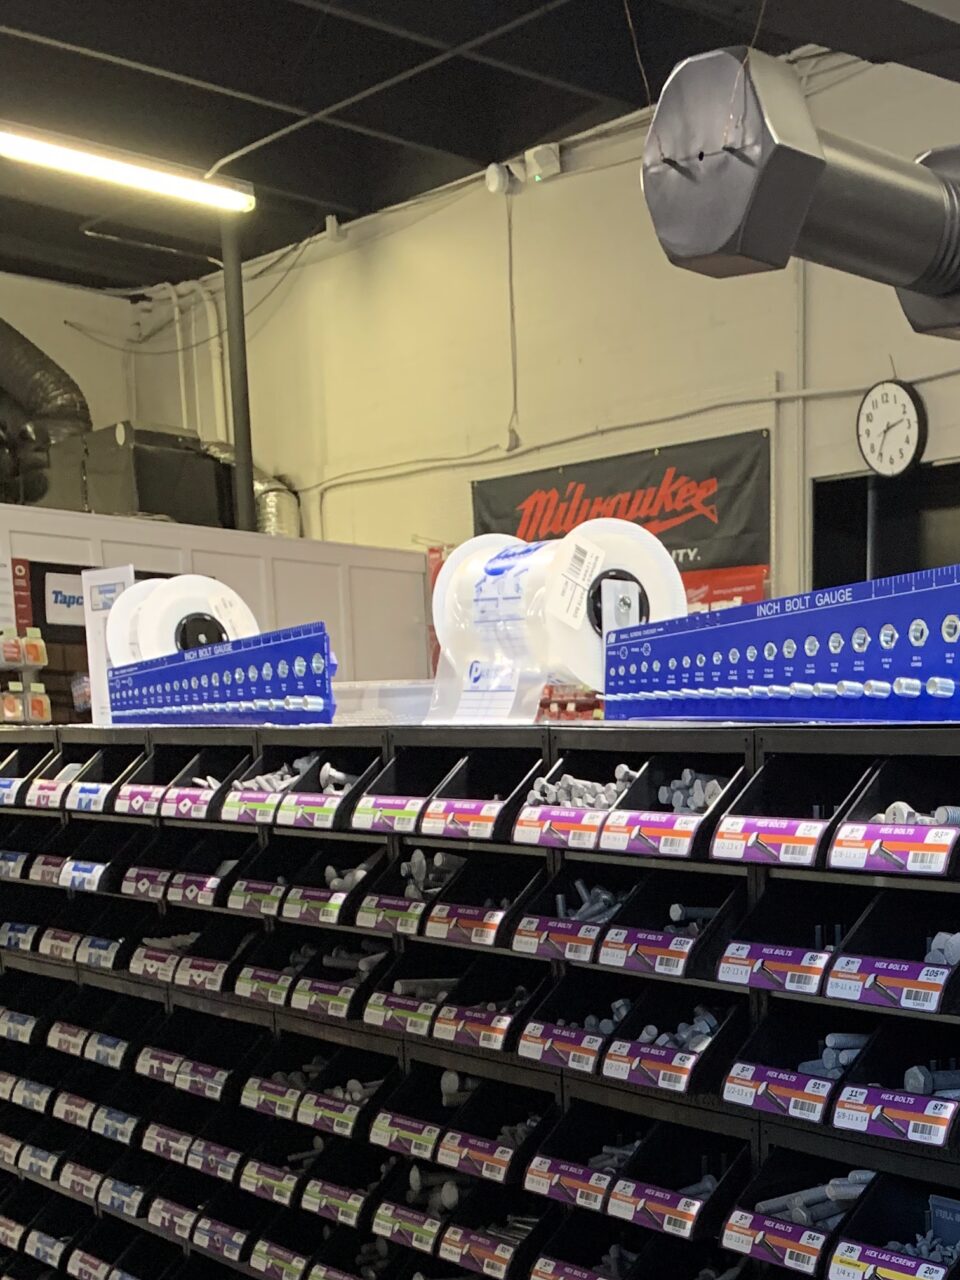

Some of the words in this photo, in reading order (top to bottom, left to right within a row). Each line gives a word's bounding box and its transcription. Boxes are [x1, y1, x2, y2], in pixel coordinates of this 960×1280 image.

[756, 603, 780, 617] INCH
[785, 596, 810, 612] BOLT
[815, 588, 852, 606] GAUGE
